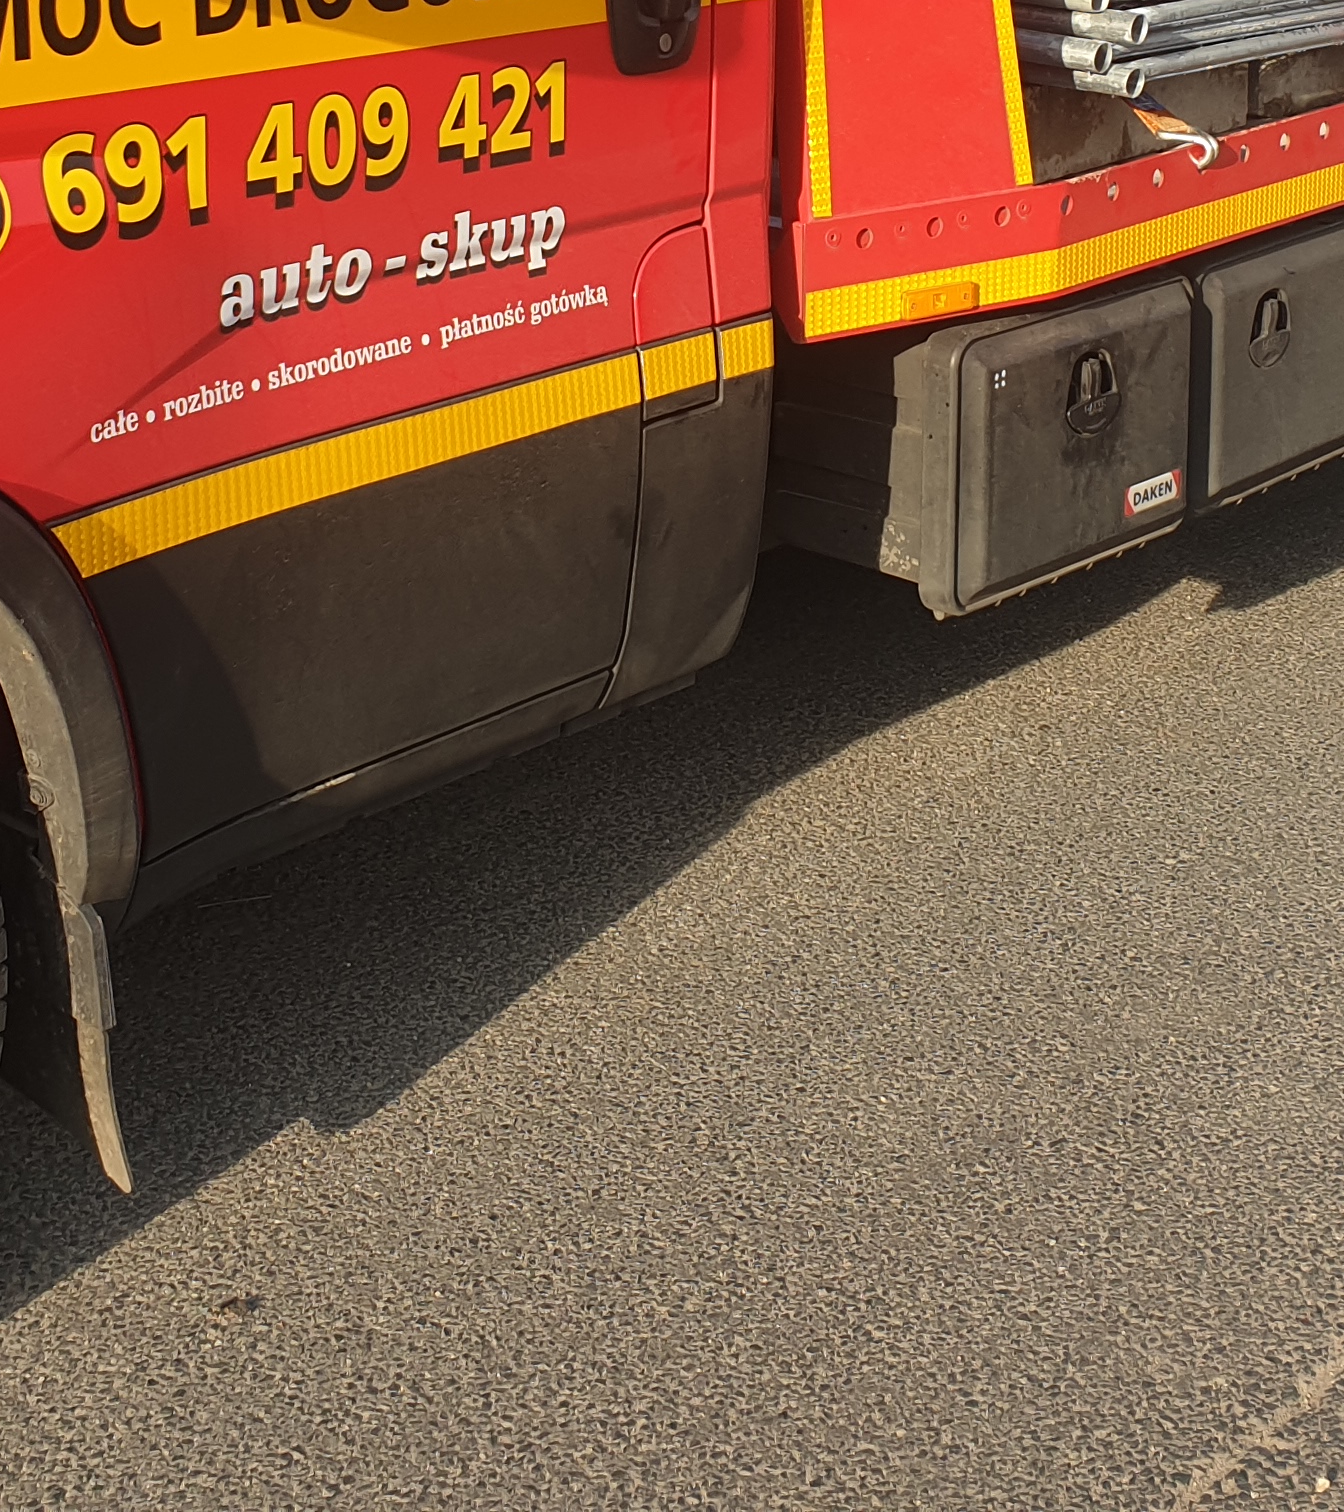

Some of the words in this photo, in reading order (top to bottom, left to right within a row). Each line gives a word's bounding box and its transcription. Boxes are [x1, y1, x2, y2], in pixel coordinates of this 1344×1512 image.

[41, 115, 208, 240] 691
[246, 86, 410, 200] 409
[438, 60, 567, 164] 421
[220, 243, 372, 328] auto
[416, 205, 566, 280] skup
[90, 409, 139, 443] całe
[163, 379, 244, 421] rozbite
[268, 334, 412, 390] skorodowane
[439, 300, 526, 349] płatność
[529, 284, 608, 325] gotówką
[1132, 479, 1173, 506] DAKEN
